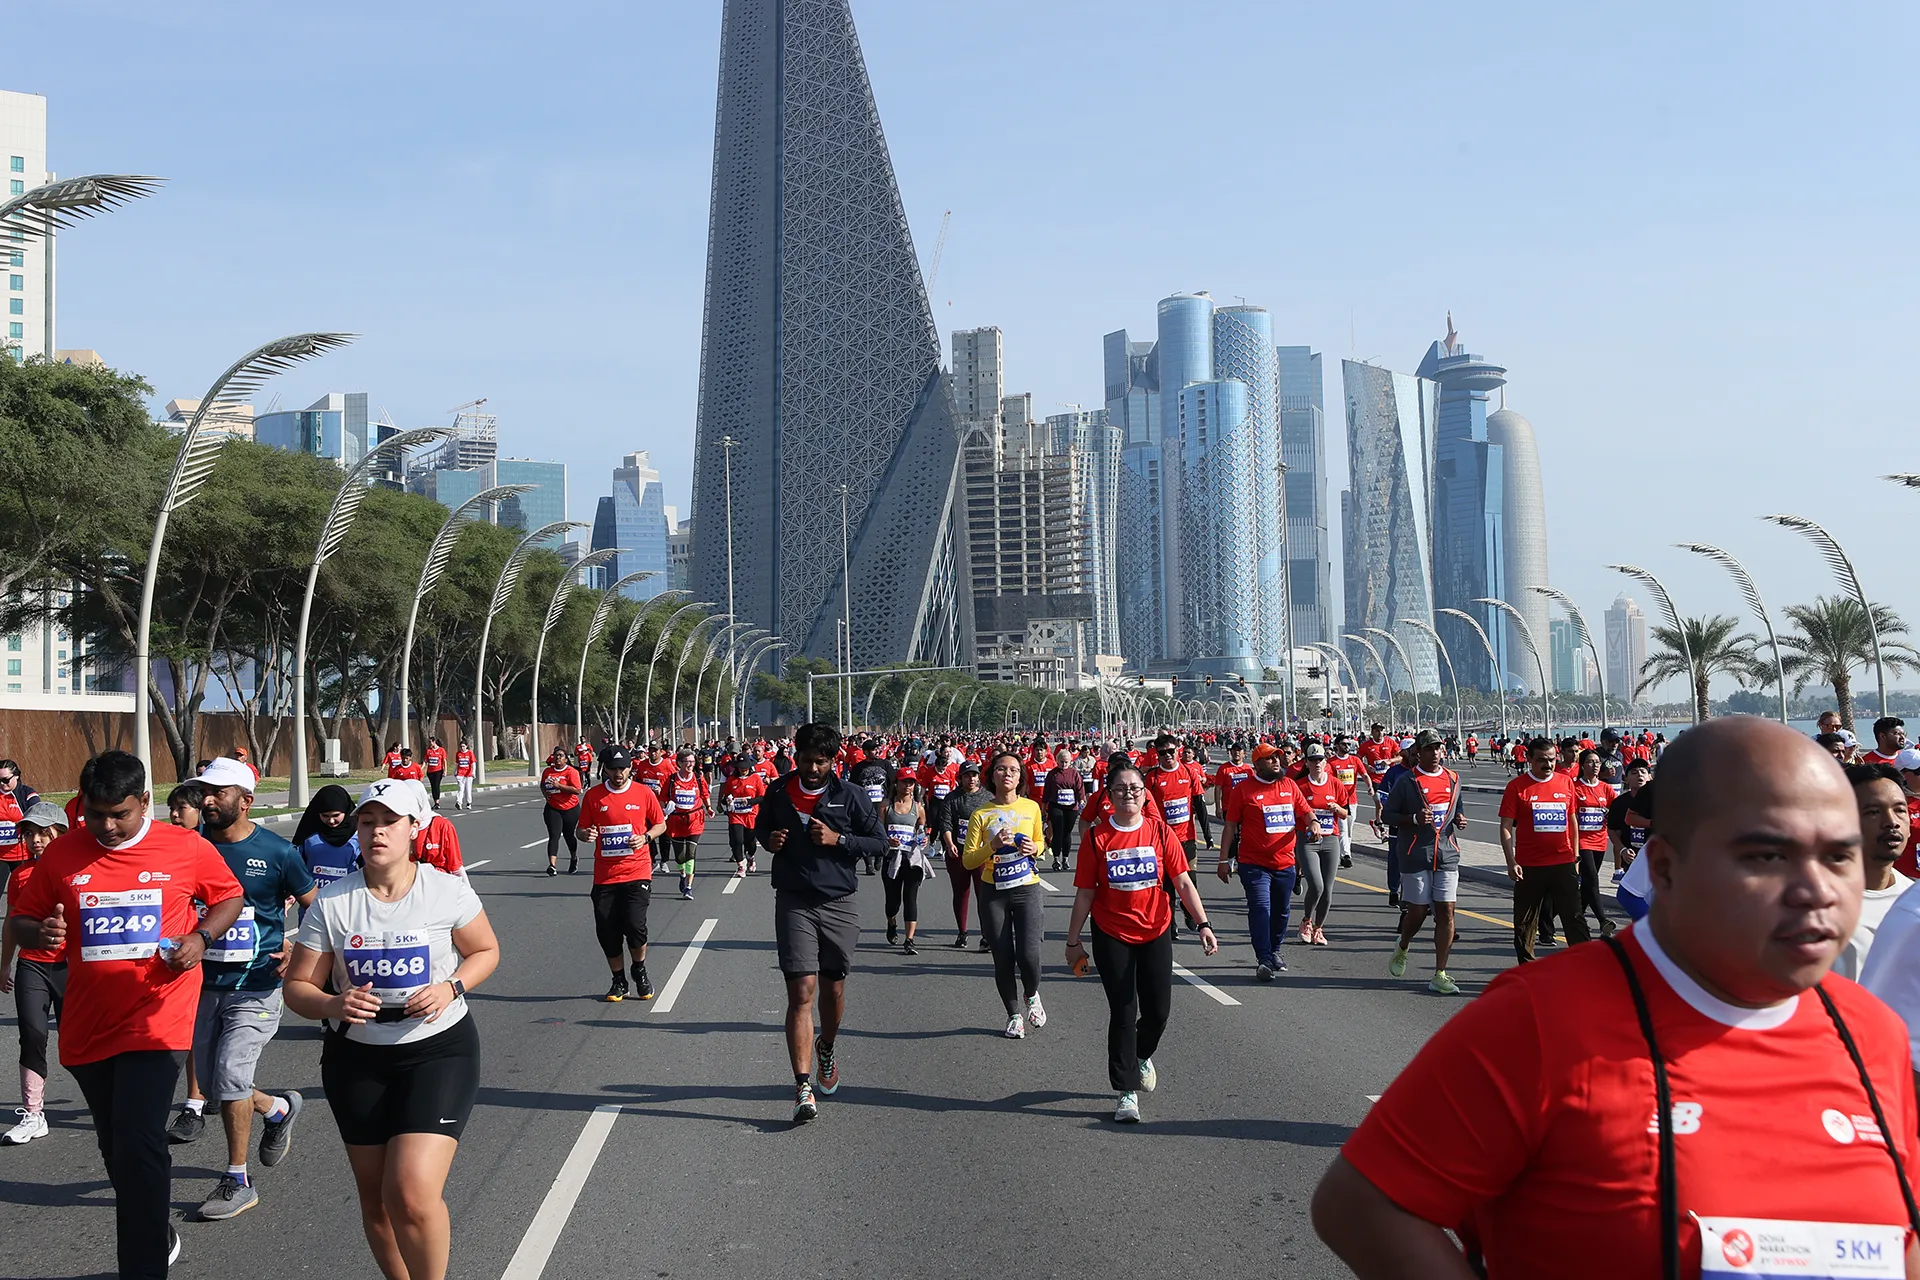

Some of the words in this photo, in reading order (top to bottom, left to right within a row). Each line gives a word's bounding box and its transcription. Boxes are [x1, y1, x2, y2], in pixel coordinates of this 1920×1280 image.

[374, 784, 391, 796] Y
[1267, 814, 1293, 823] 12819
[1534, 813, 1565, 821] 10025
[995, 861, 1028, 877] 12250
[1110, 862, 1155, 877] 10348
[314, 878, 337, 888] 112
[84, 914, 157, 935] 12249
[395, 935, 402, 943] 5
[403, 935, 418, 943] KM
[348, 956, 425, 977] 14868
[1836, 1239, 1845, 1259] 5
[1851, 1241, 1882, 1260] KM
